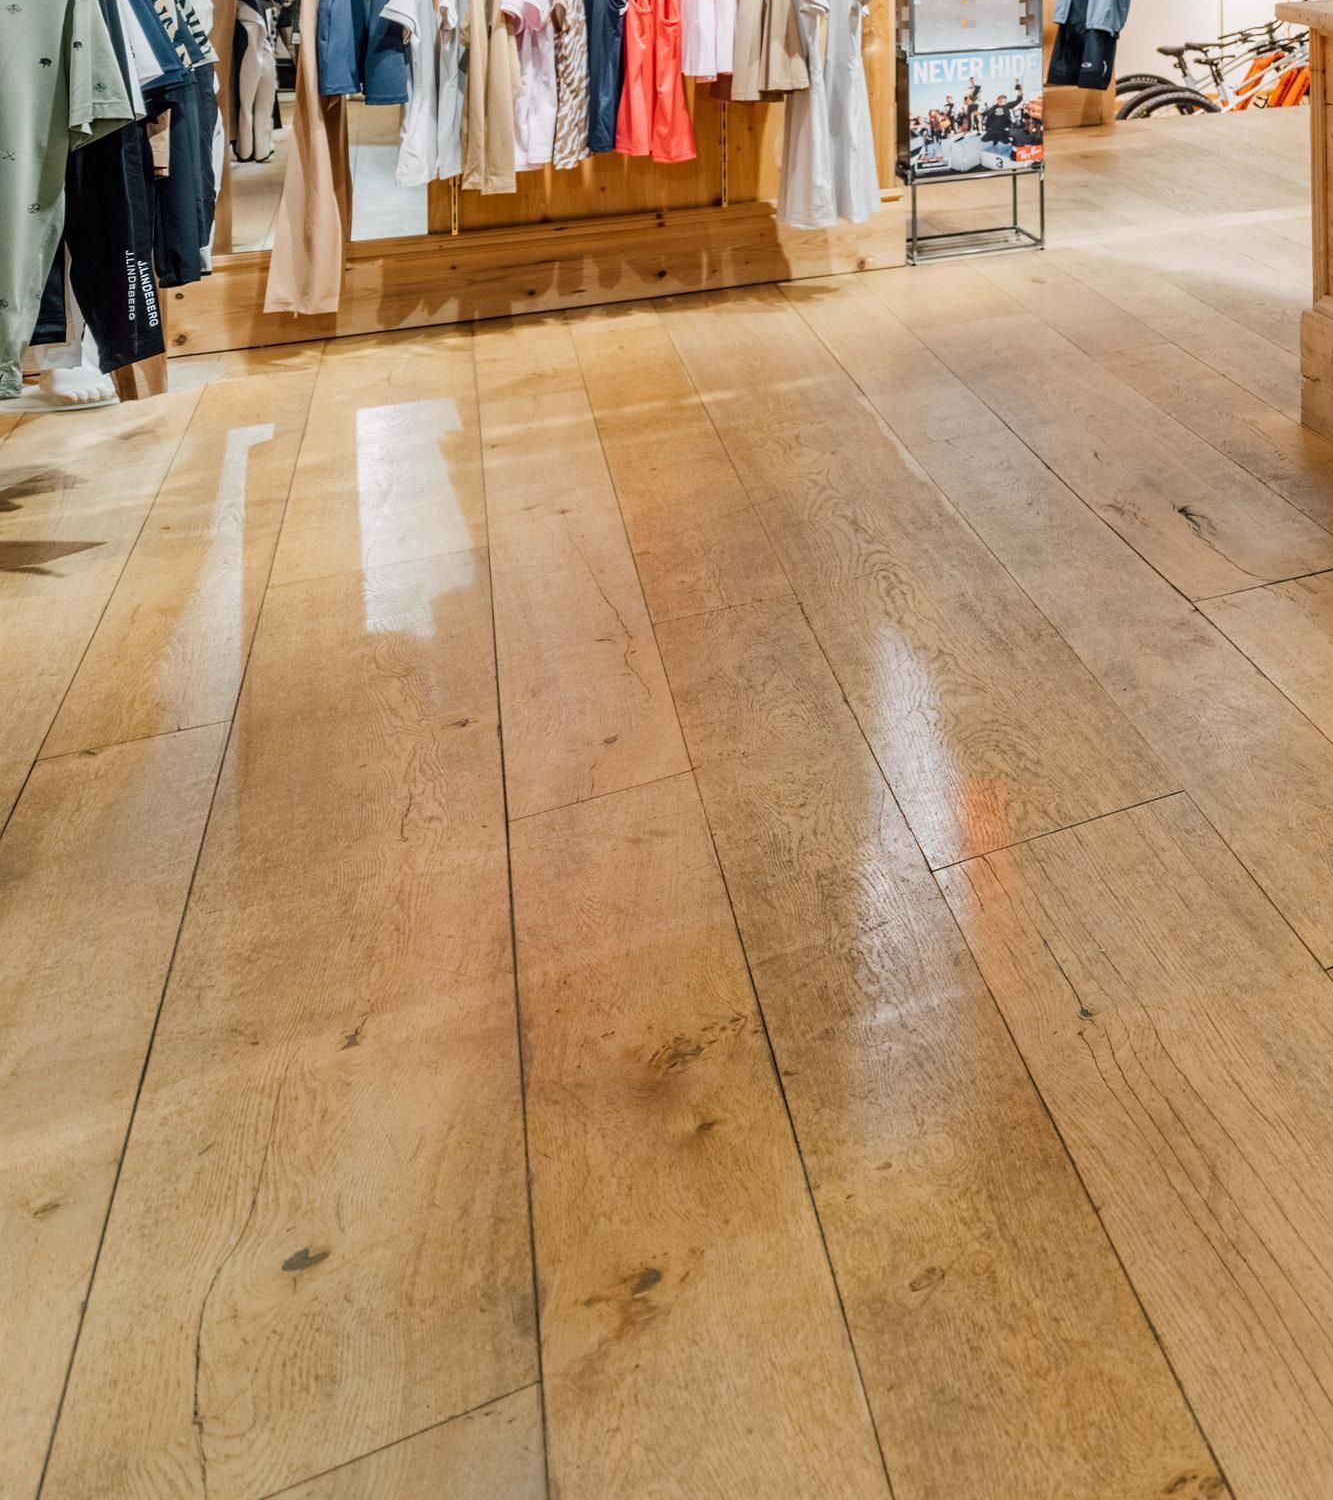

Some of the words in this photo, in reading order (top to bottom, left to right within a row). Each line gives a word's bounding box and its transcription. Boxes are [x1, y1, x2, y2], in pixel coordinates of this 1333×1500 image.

[913, 57, 984, 84] NEVER
[990, 52, 1039, 79] HIDE
[125, 250, 136, 320] J.LINDEBERG
[137, 260, 159, 327] J.LINDEBERG
